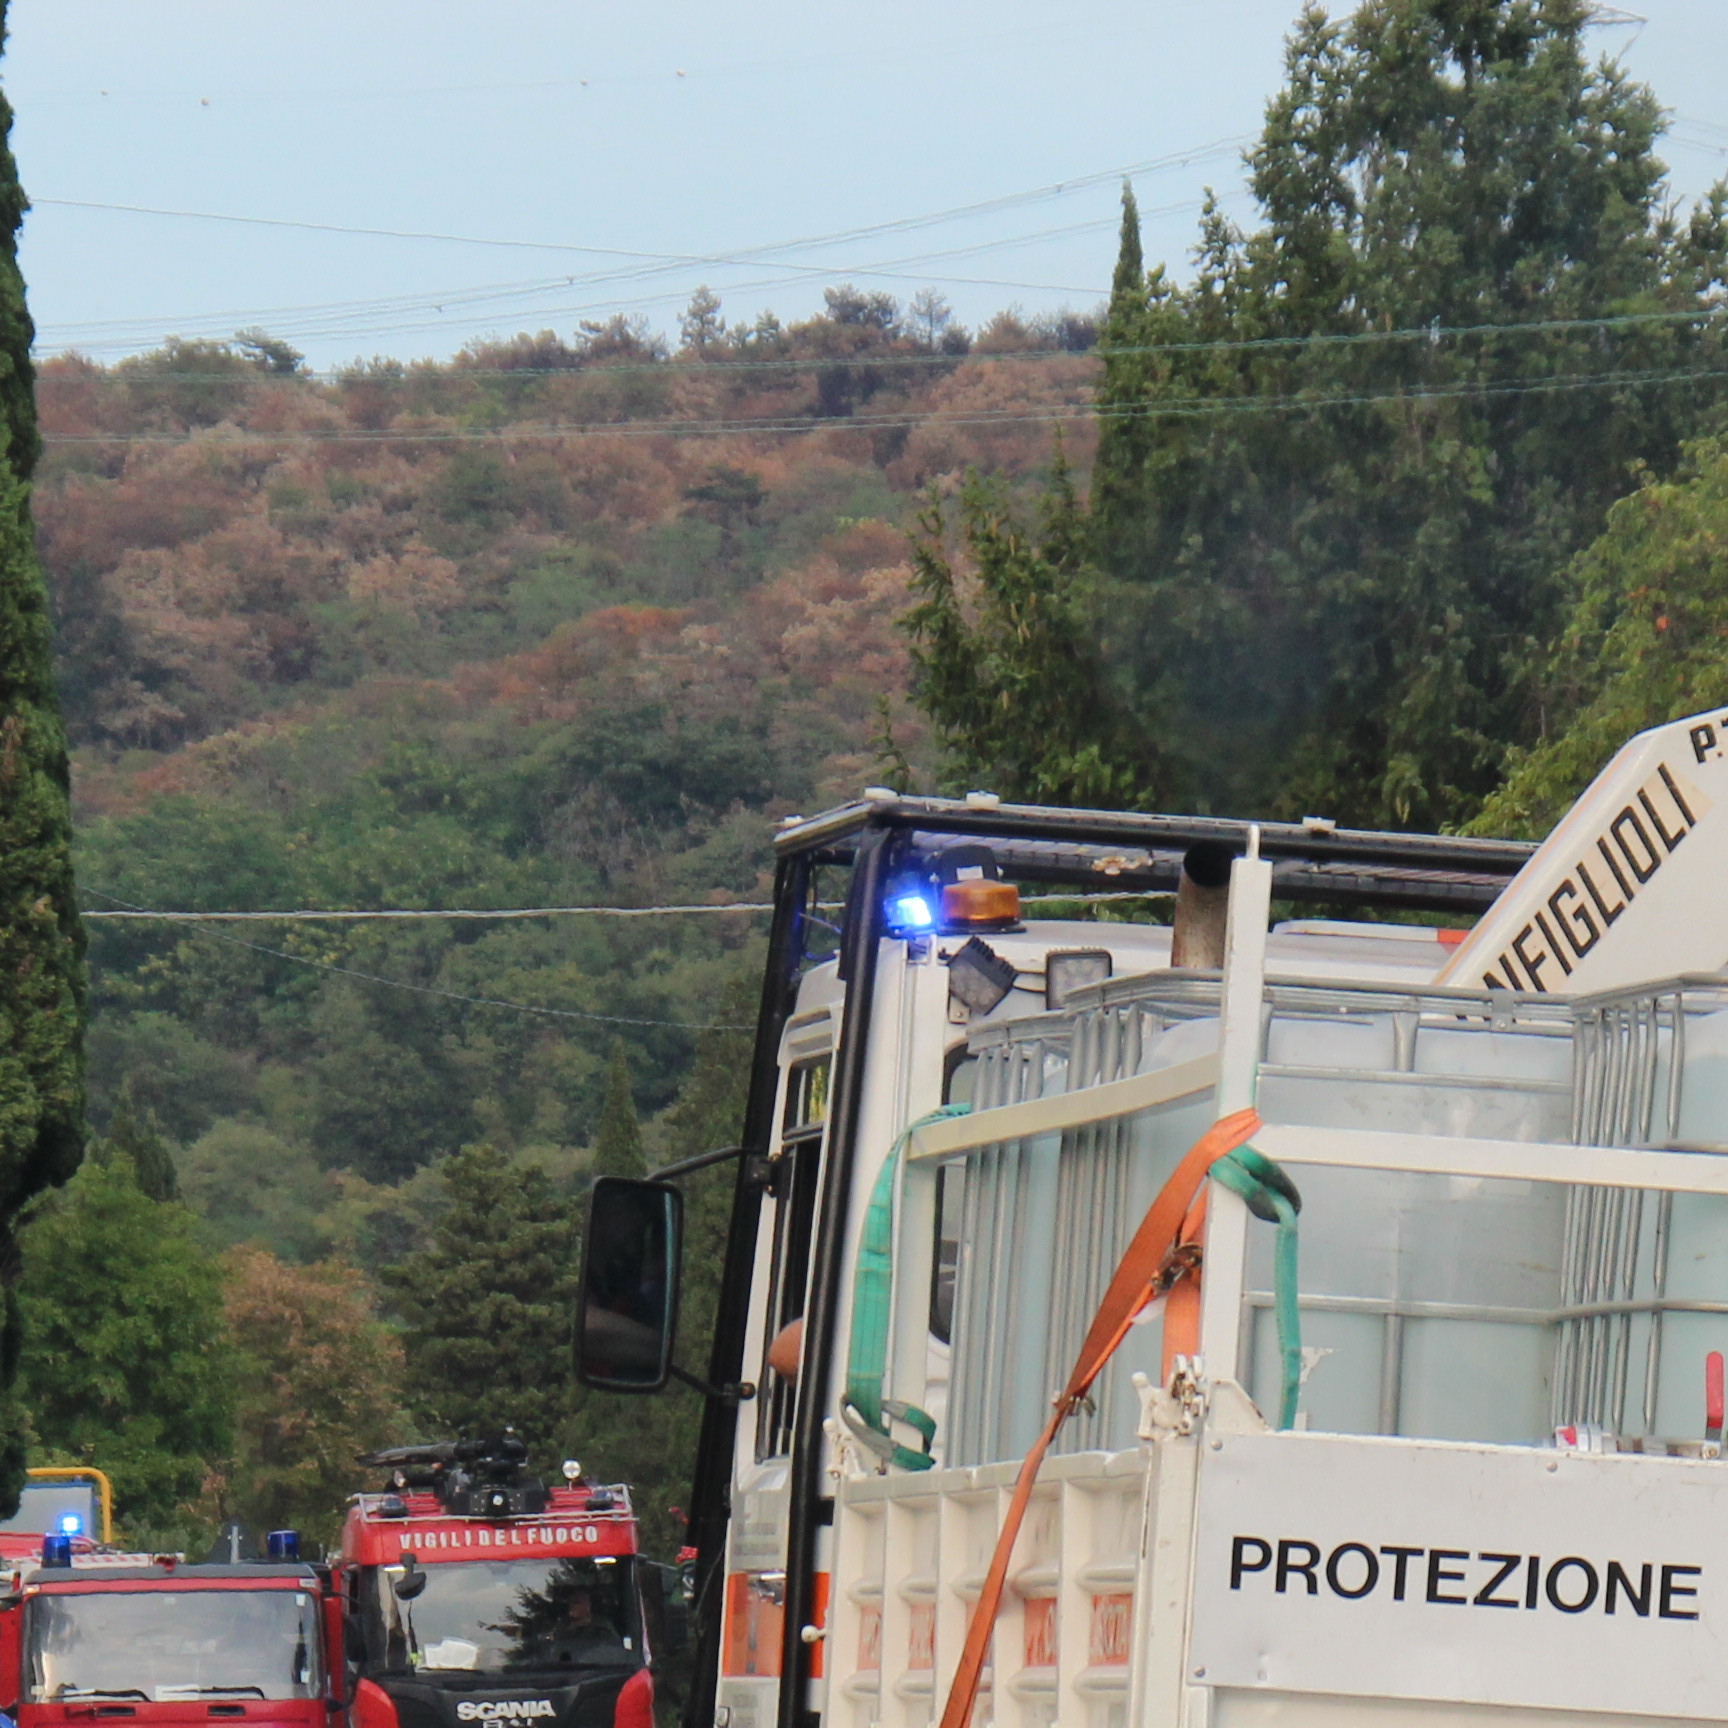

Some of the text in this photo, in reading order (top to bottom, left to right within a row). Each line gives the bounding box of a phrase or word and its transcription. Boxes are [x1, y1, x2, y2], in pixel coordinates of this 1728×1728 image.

[1482, 762, 1696, 993] NFIGLIOLI
[399, 1525, 599, 1549] VIGILI DEL FUOCO
[1230, 1536, 1702, 1620] PROTEZIONE
[457, 1699, 557, 1721] SCANIA
